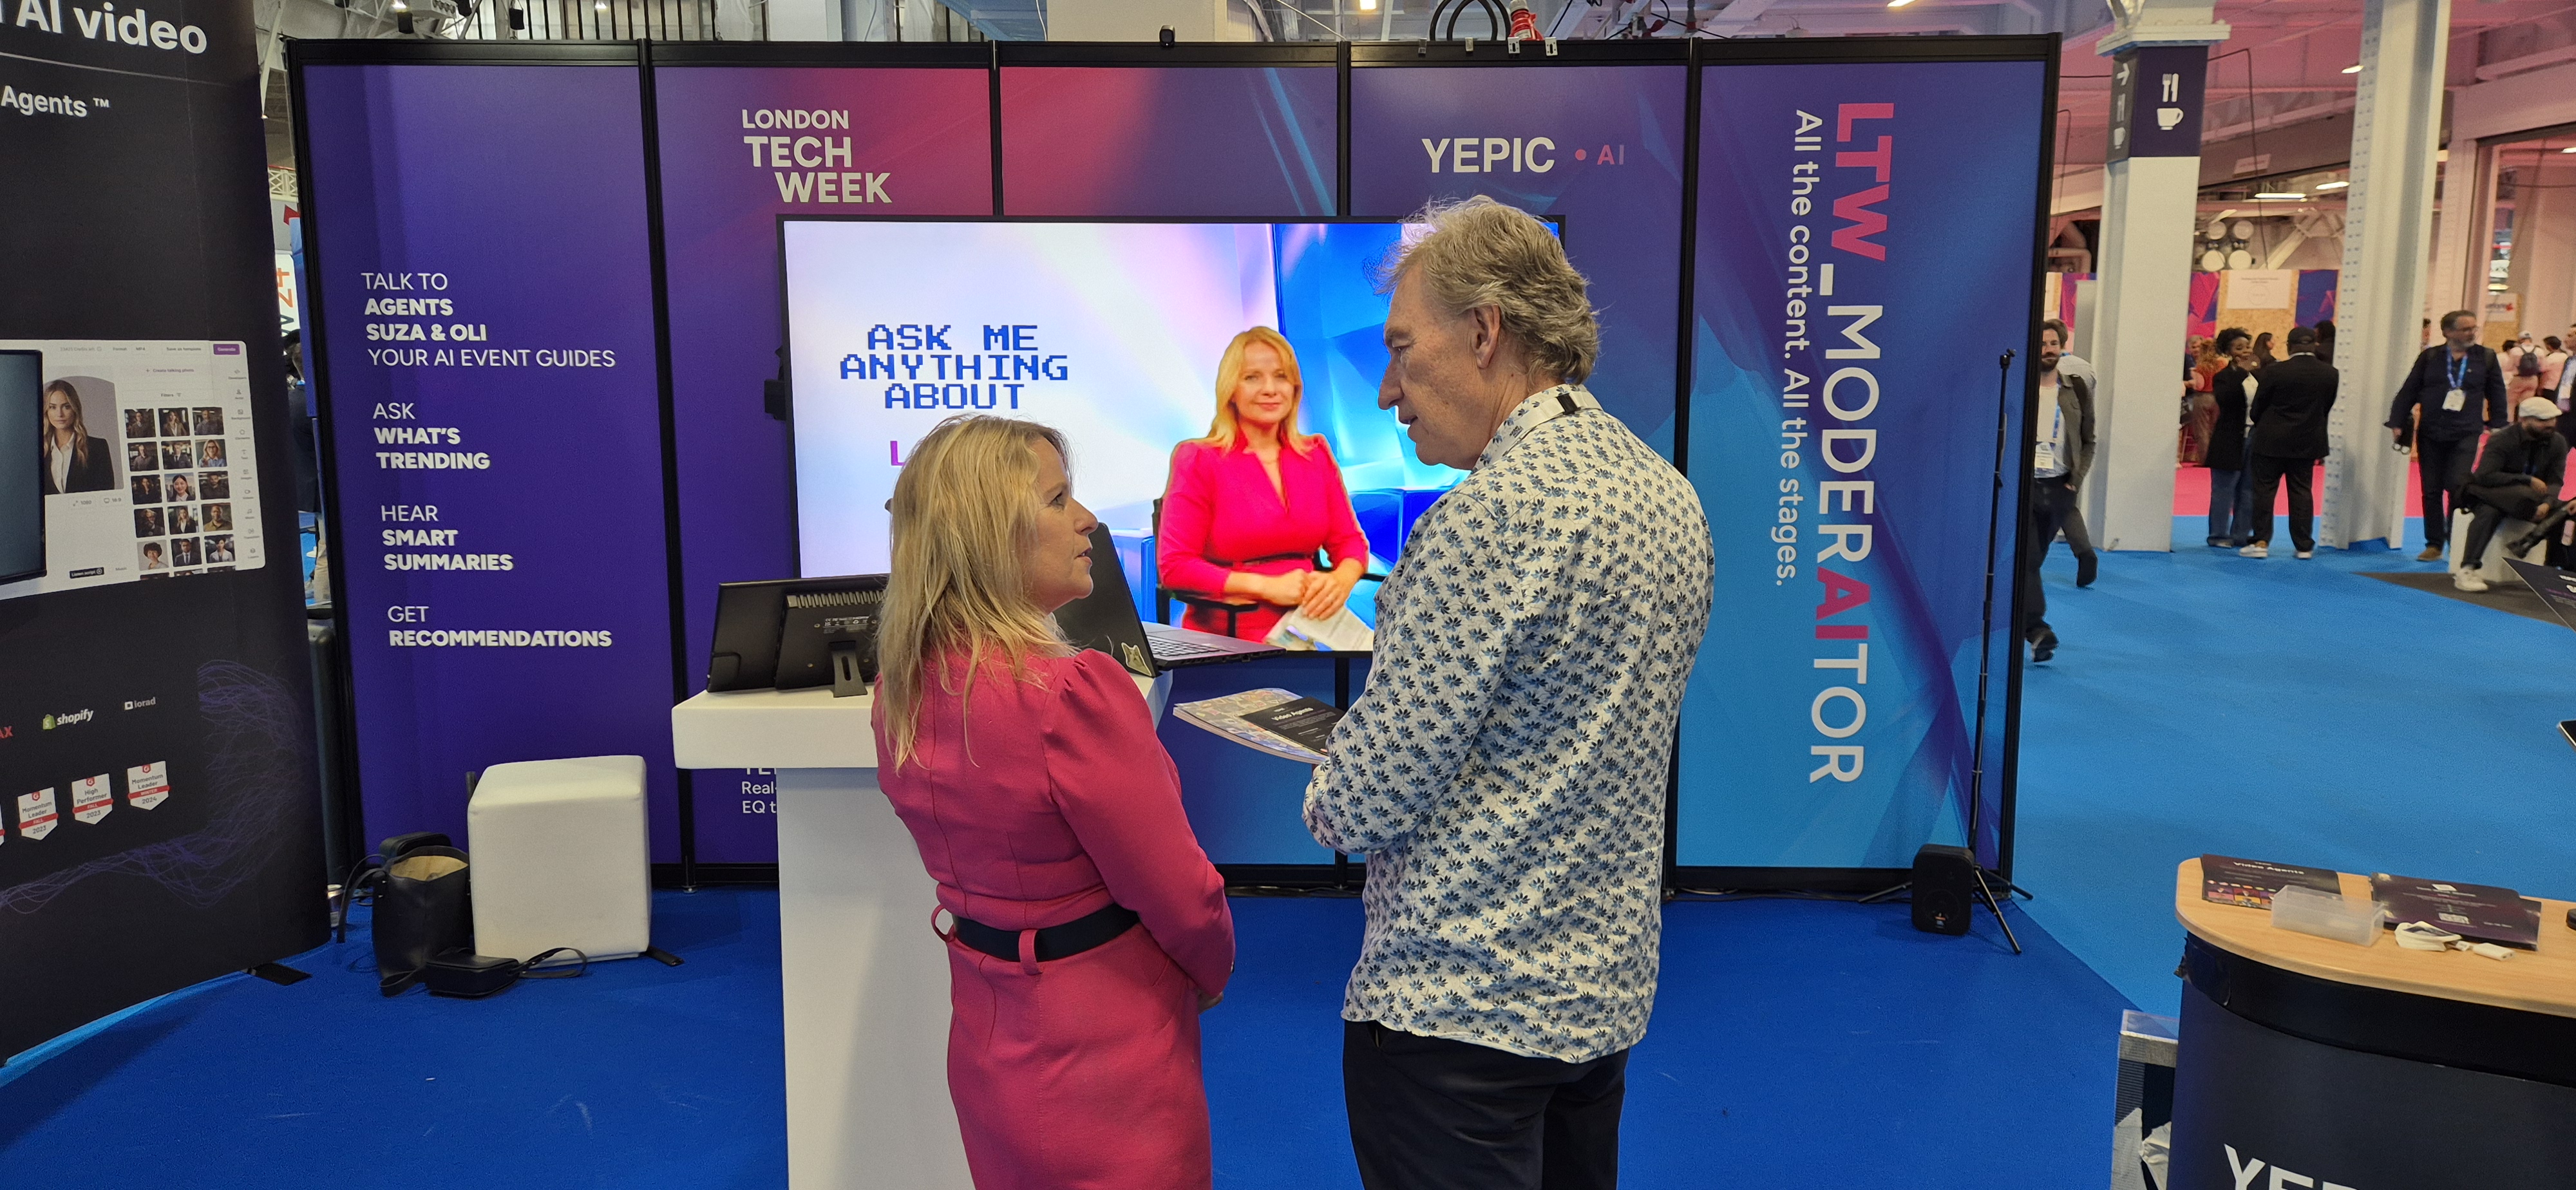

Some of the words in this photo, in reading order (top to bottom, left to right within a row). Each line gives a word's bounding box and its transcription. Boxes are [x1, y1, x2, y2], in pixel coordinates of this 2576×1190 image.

[16, 0, 62, 33] AI
[73, 1, 207, 54] video
[1, 85, 88, 118] Agents
[742, 109, 849, 129] LONDON
[1794, 109, 1823, 151] All
[744, 136, 852, 167] TECH
[1421, 137, 1555, 173] YEPIC
[1597, 144, 1624, 165] AI
[775, 172, 892, 203] WEEK
[1791, 162, 1820, 215] the
[361, 273, 413, 290] TALK
[417, 273, 448, 290] TO
[1785, 225, 1812, 359] content.
[365, 298, 453, 316] AGENTS
[366, 324, 425, 341] SUZA
[431, 324, 446, 341] &
[450, 324, 487, 341] OLI
[868, 324, 952, 350] ASK
[983, 325, 1038, 351] ME
[368, 348, 429, 366] YOUR
[434, 348, 454, 366] AI
[461, 349, 531, 366] EVENT
[536, 350, 616, 368] GUIDES
[840, 354, 1068, 381] ANYTHING
[885, 383, 1025, 409] ABOUT
[1783, 368, 1810, 408] All
[372, 402, 415, 420] ASK
[374, 427, 461, 444] WHAT'S
[1780, 417, 1808, 469] the
[375, 452, 490, 469] TRENDING
[381, 505, 439, 522] HEAR
[382, 529, 458, 547] SMART
[1771, 478, 1804, 586] stages.
[384, 554, 514, 571] SUMMARIES
[387, 606, 429, 623] GET
[389, 630, 612, 647] RECOMMENDATIONS
[134, 697, 156, 708] iorad
[57, 708, 94, 726] shopify
[131, 774, 163, 784] Momentum
[22, 802, 52, 813] Momentum
[77, 793, 107, 805] Performer
[743, 800, 765, 813] EQ
[28, 809, 47, 818] Leader
[86, 810, 101, 818] 2023
[33, 826, 46, 834] 2023
